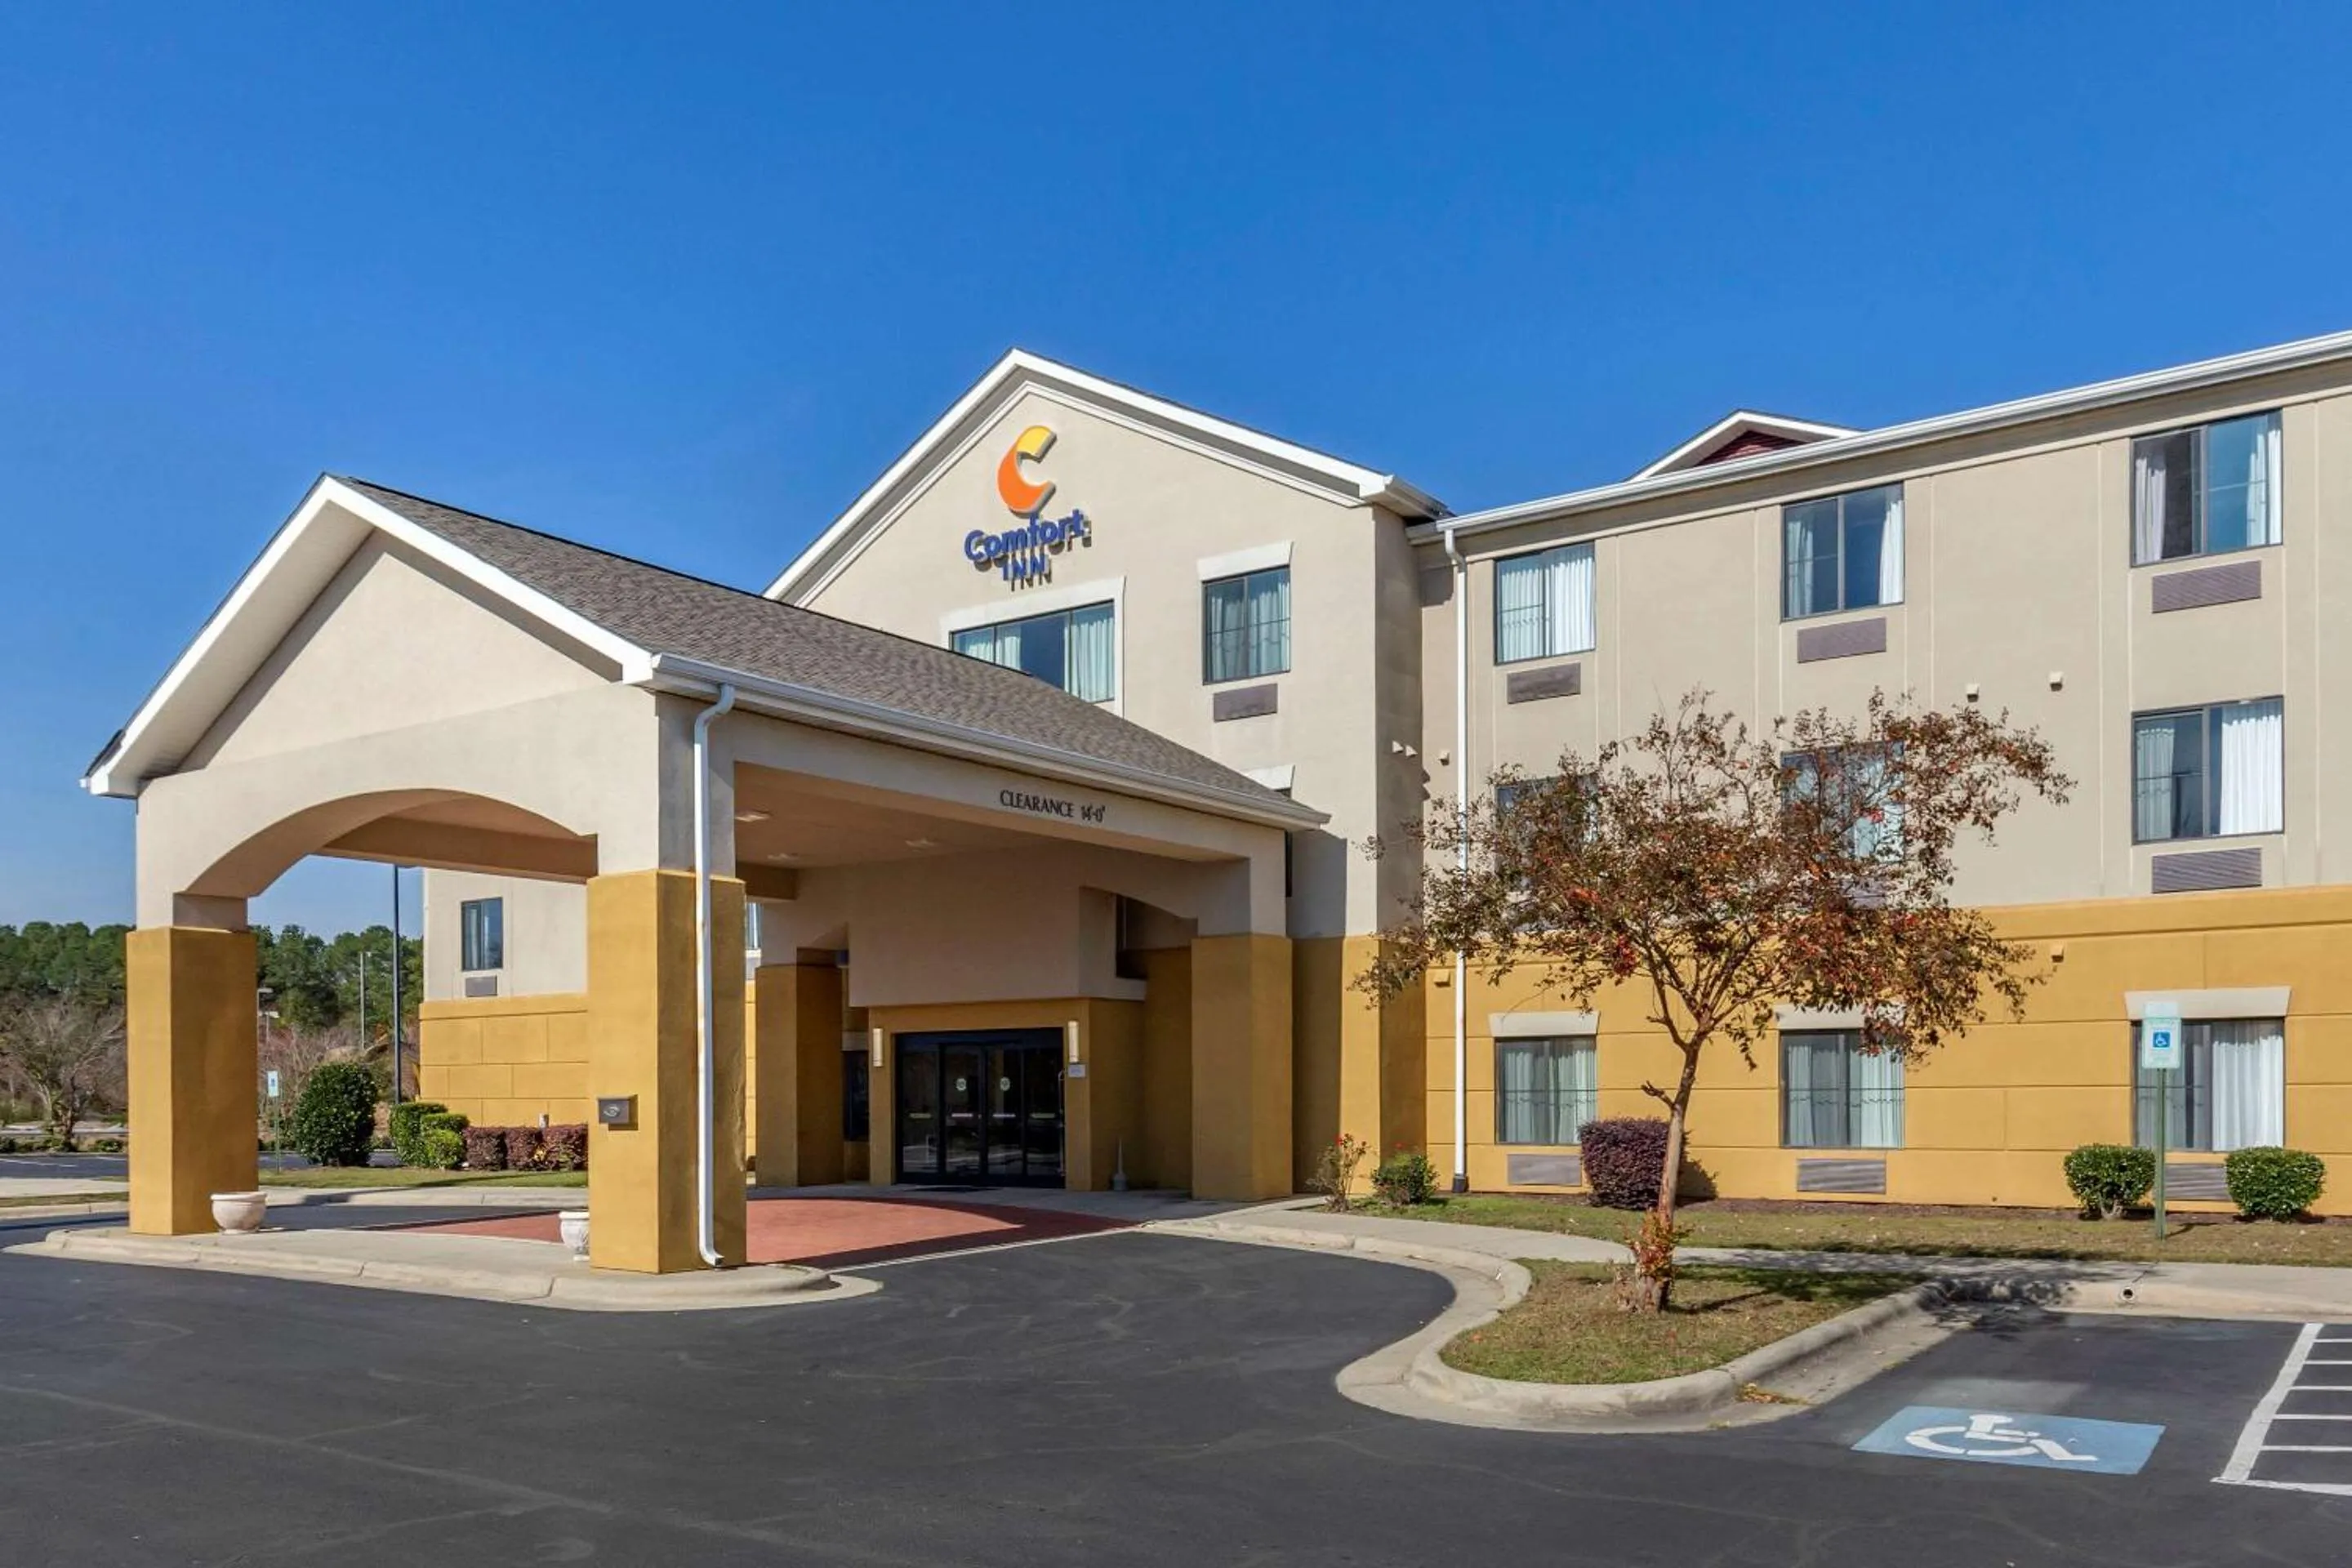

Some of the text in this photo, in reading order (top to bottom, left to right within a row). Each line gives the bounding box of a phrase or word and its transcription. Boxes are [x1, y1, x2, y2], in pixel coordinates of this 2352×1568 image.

[964, 509, 1085, 561] Comfort
[1003, 554, 1045, 581] INN
[1000, 789, 1075, 817] CLEARANCE
